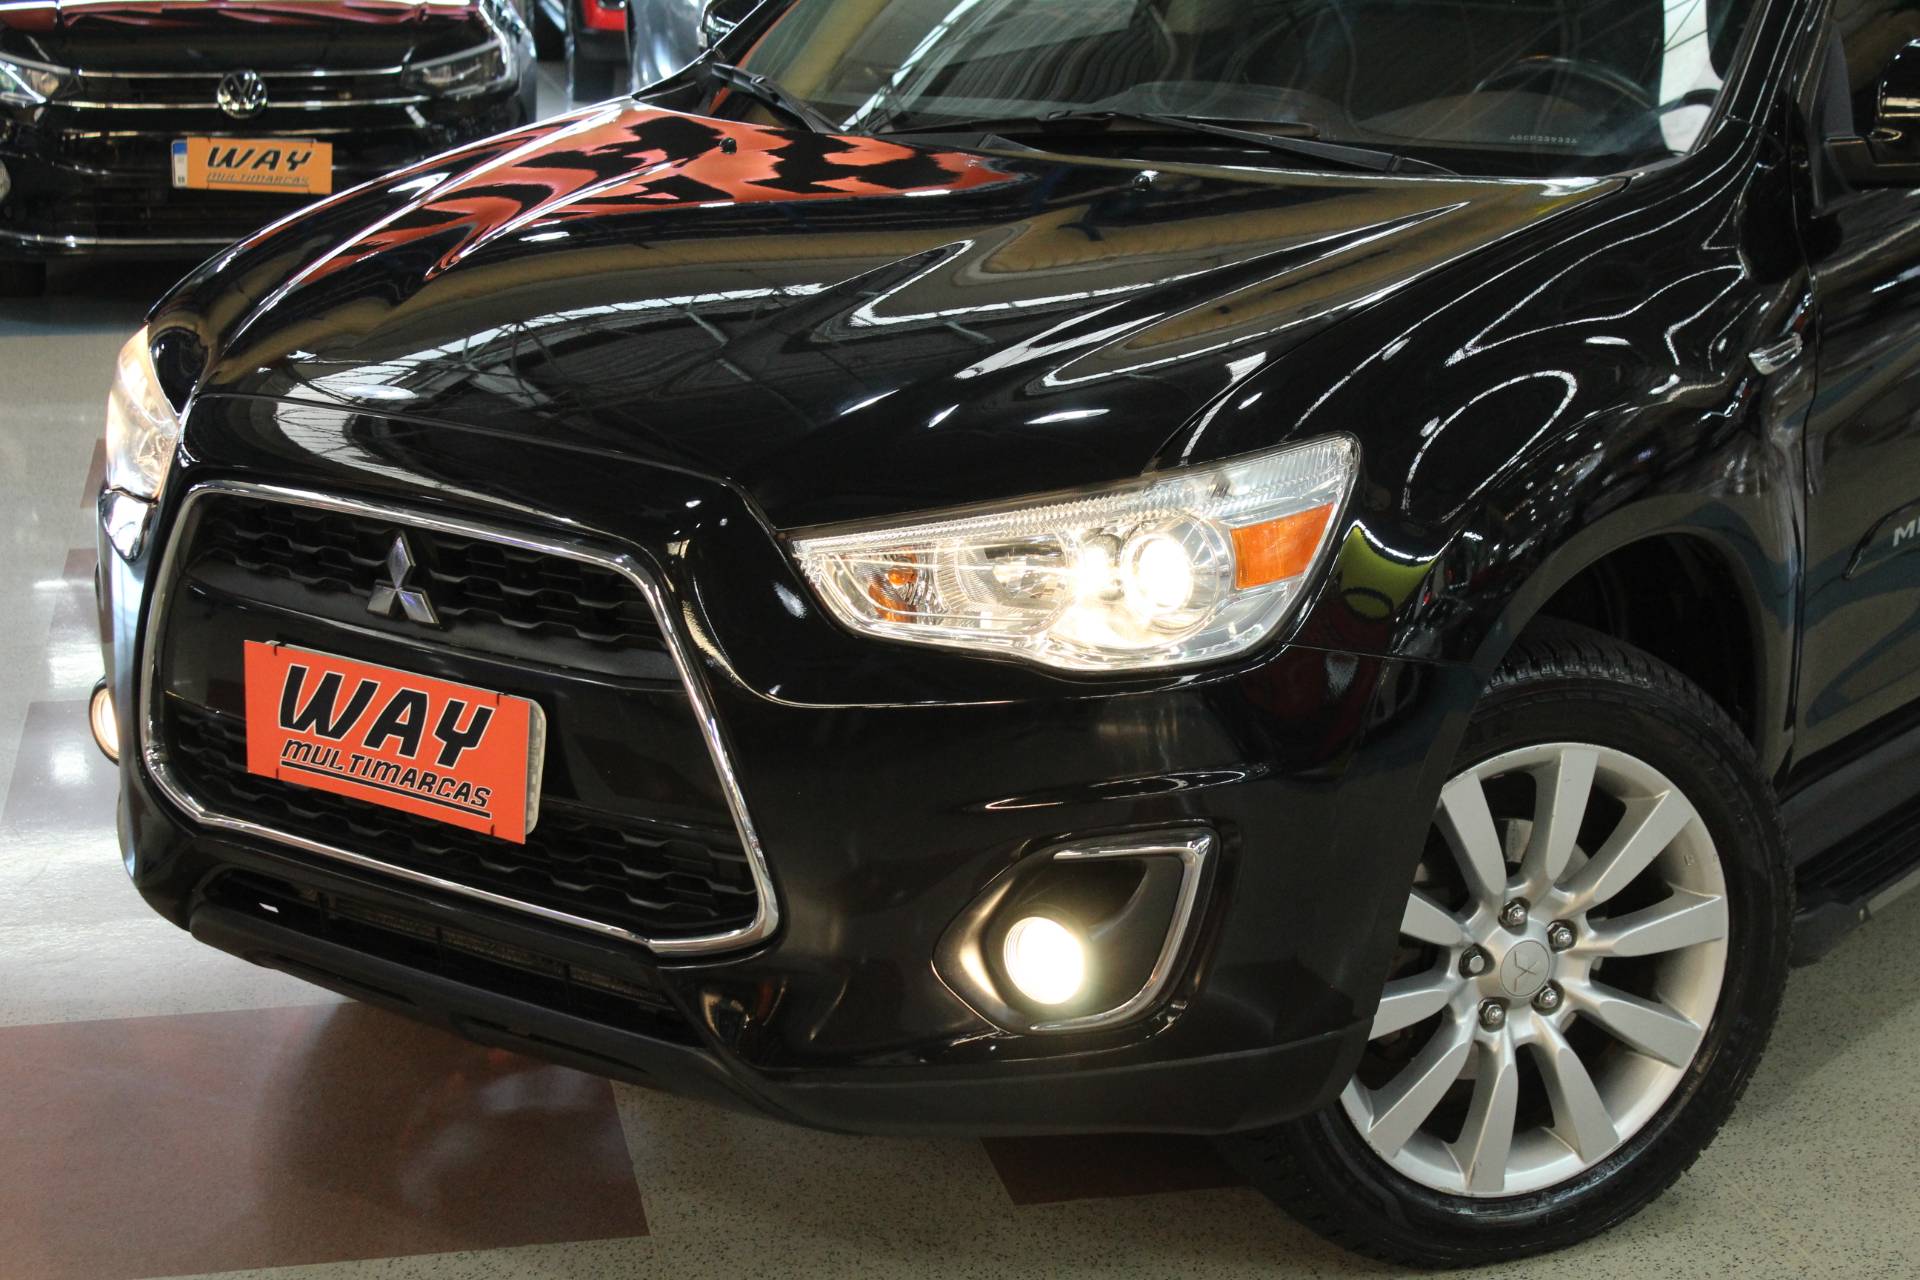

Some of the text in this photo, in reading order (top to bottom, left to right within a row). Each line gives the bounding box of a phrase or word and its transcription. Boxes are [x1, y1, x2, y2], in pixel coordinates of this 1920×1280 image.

[207, 146, 312, 172] WAY
[278, 663, 496, 770] WAY
[280, 738, 493, 809] MULTIMARCAS
